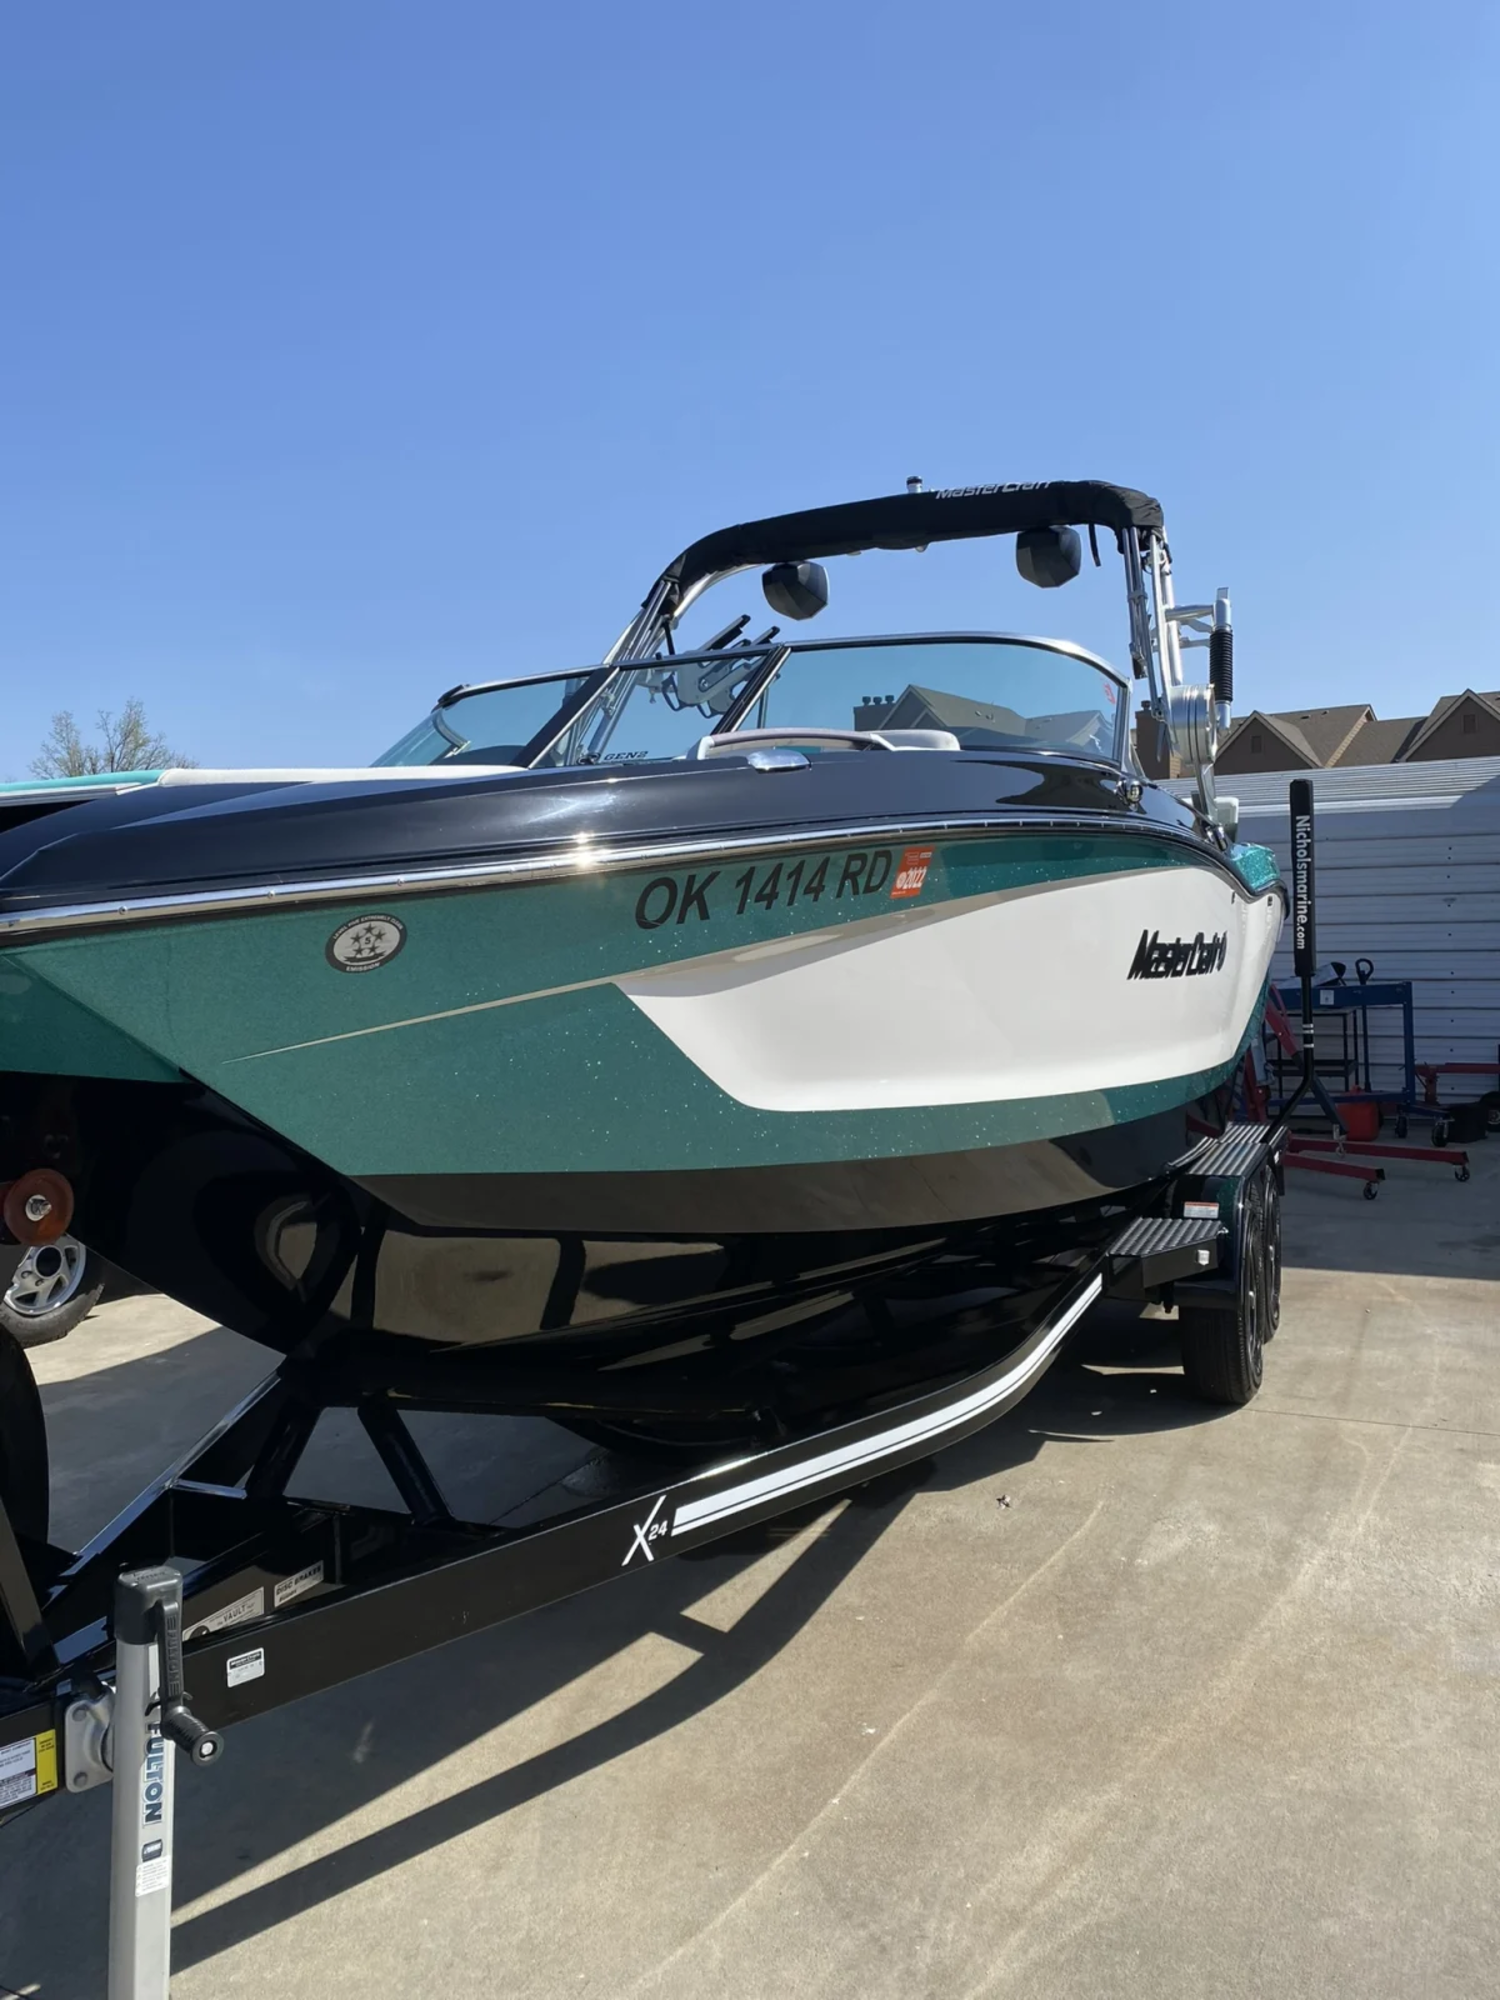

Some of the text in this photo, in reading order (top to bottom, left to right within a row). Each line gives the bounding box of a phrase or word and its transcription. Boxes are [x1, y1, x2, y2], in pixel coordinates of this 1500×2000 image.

[634, 849, 893, 929] OK 1414 RD
[1296, 815, 1312, 949] Nicholsmarine.com
[223, 1604, 246, 1622] VAULT
[276, 1581, 293, 1596] DISC
